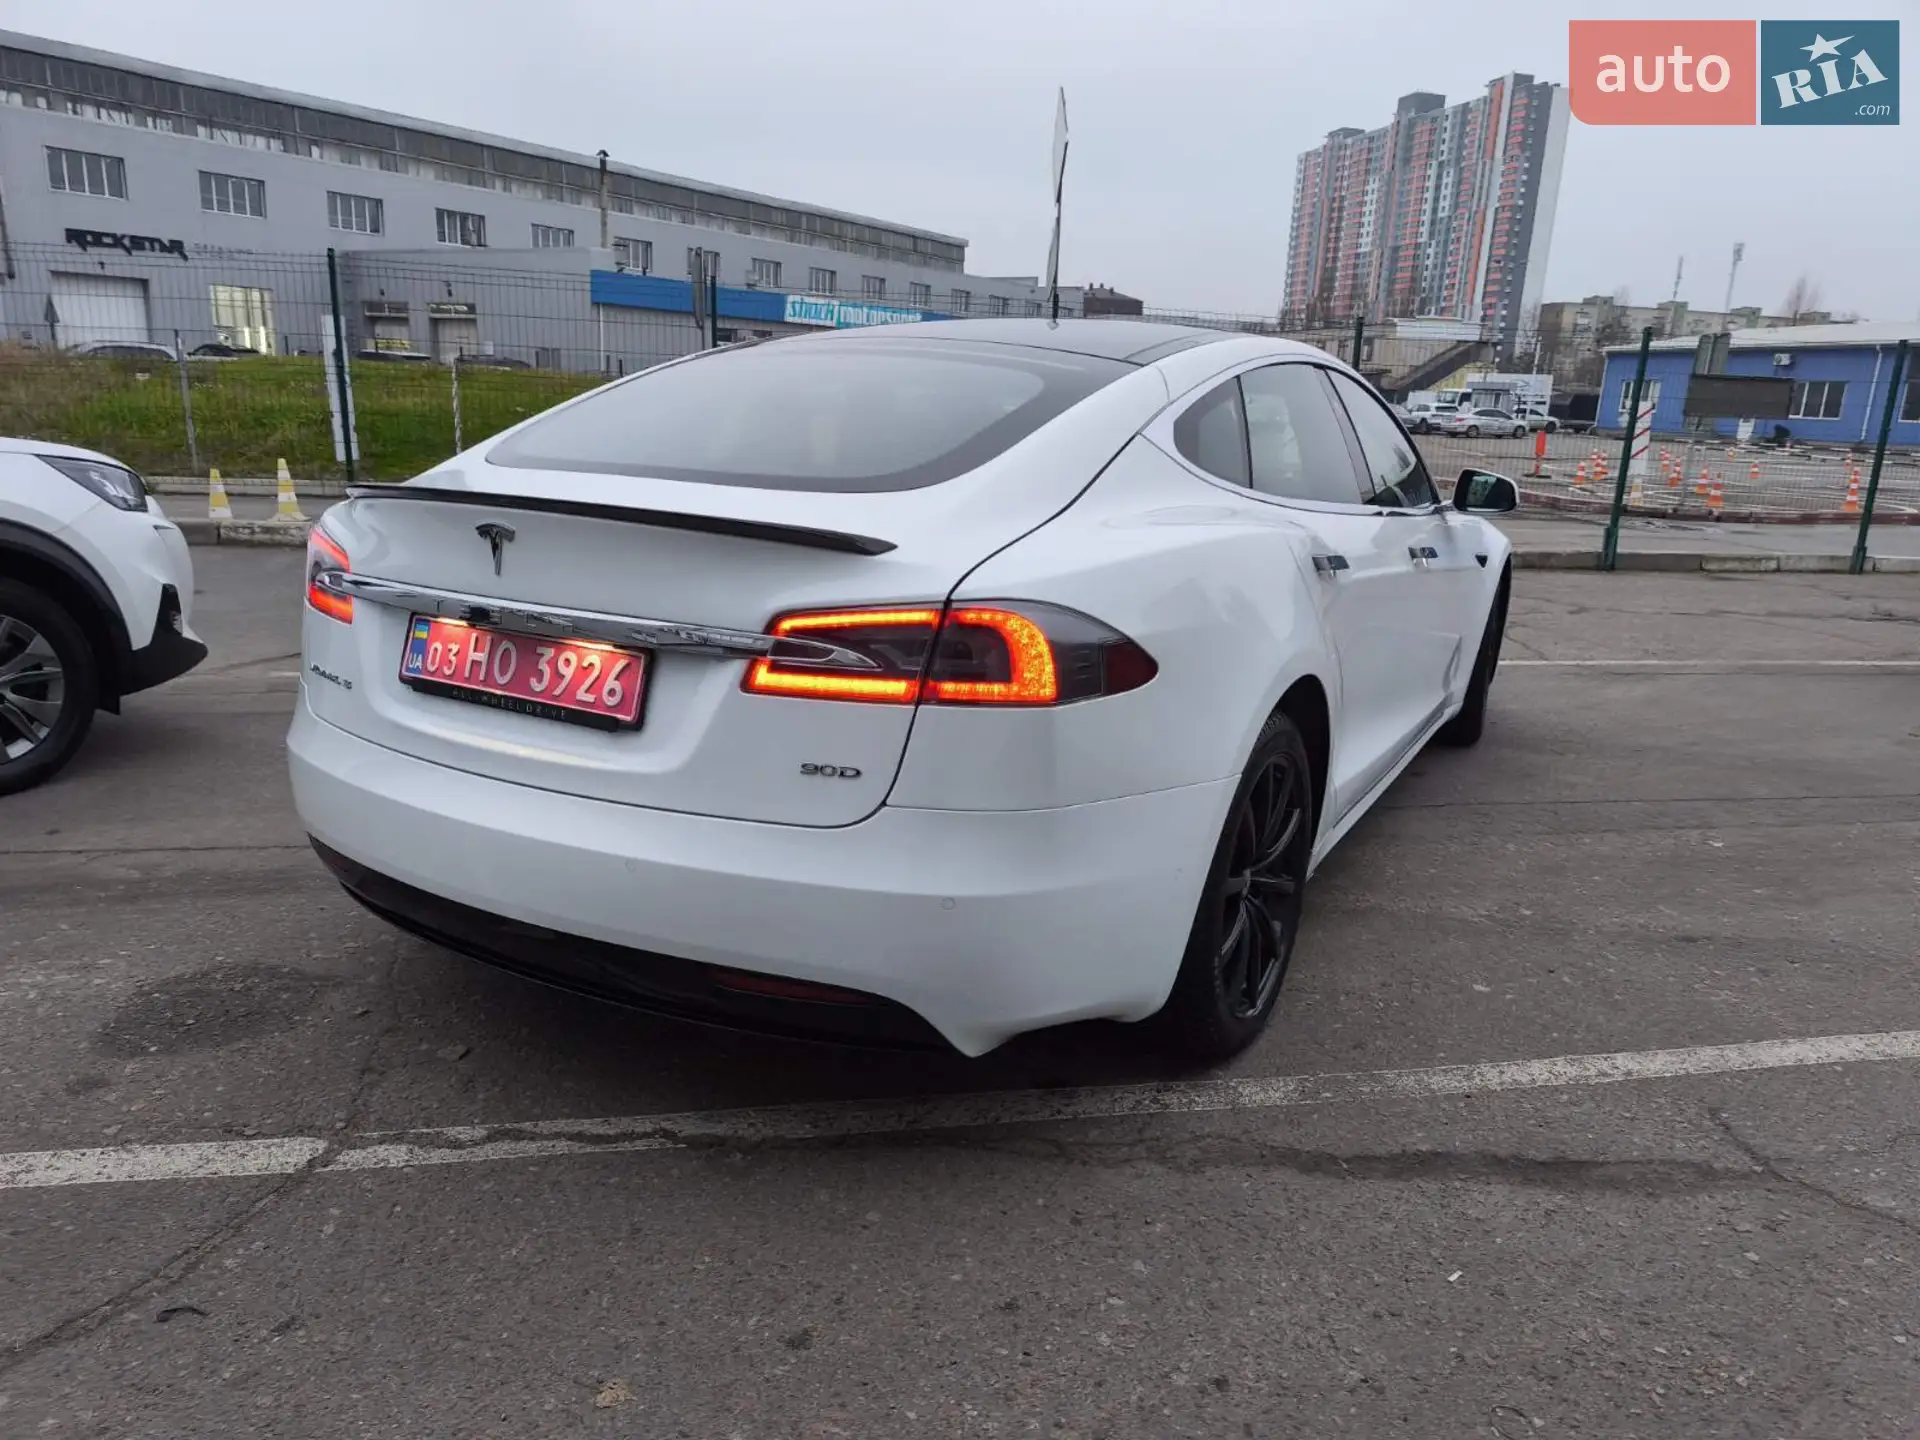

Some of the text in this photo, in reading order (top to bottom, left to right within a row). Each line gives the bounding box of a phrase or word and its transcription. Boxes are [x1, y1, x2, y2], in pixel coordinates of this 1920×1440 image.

[65, 228, 188, 262] ROCKSTAR
[408, 653, 423, 671] UA
[426, 632, 632, 707] 03 HO 3926
[799, 762, 862, 779] 90D
